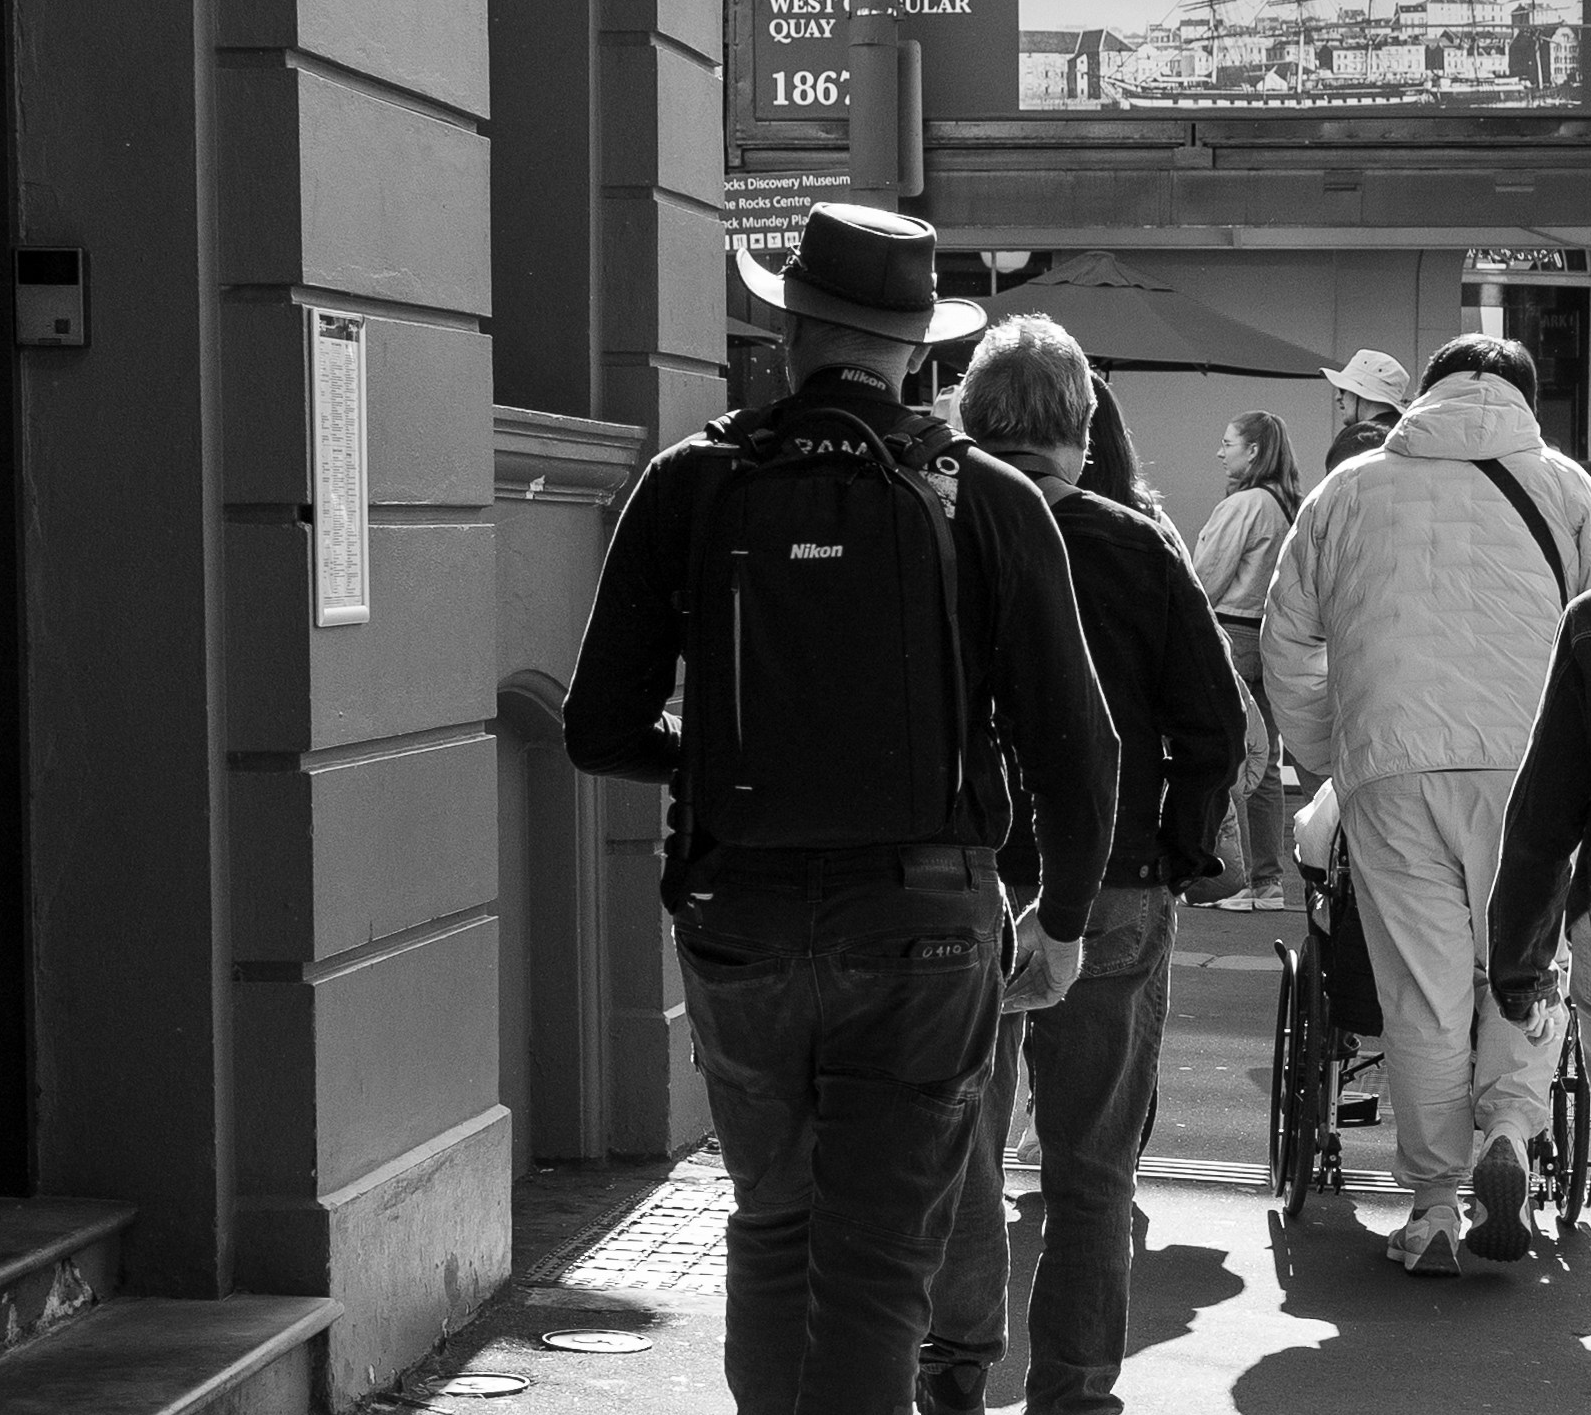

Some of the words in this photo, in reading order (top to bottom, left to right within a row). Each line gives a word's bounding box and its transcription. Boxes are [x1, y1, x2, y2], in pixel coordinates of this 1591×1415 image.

[769, 19, 836, 44] QUAY
[723, 178, 746, 191] ocks
[747, 177, 800, 190] Discovery
[802, 174, 850, 187] Museum
[739, 197, 770, 209] Rocks
[773, 195, 811, 208] Centre
[721, 217, 740, 229] ack
[742, 215, 789, 229] Mundey
[791, 214, 809, 226] Pla
[841, 368, 887, 391] Nikon
[790, 543, 843, 559] Nikon
[922, 944, 962, 959] 0410
